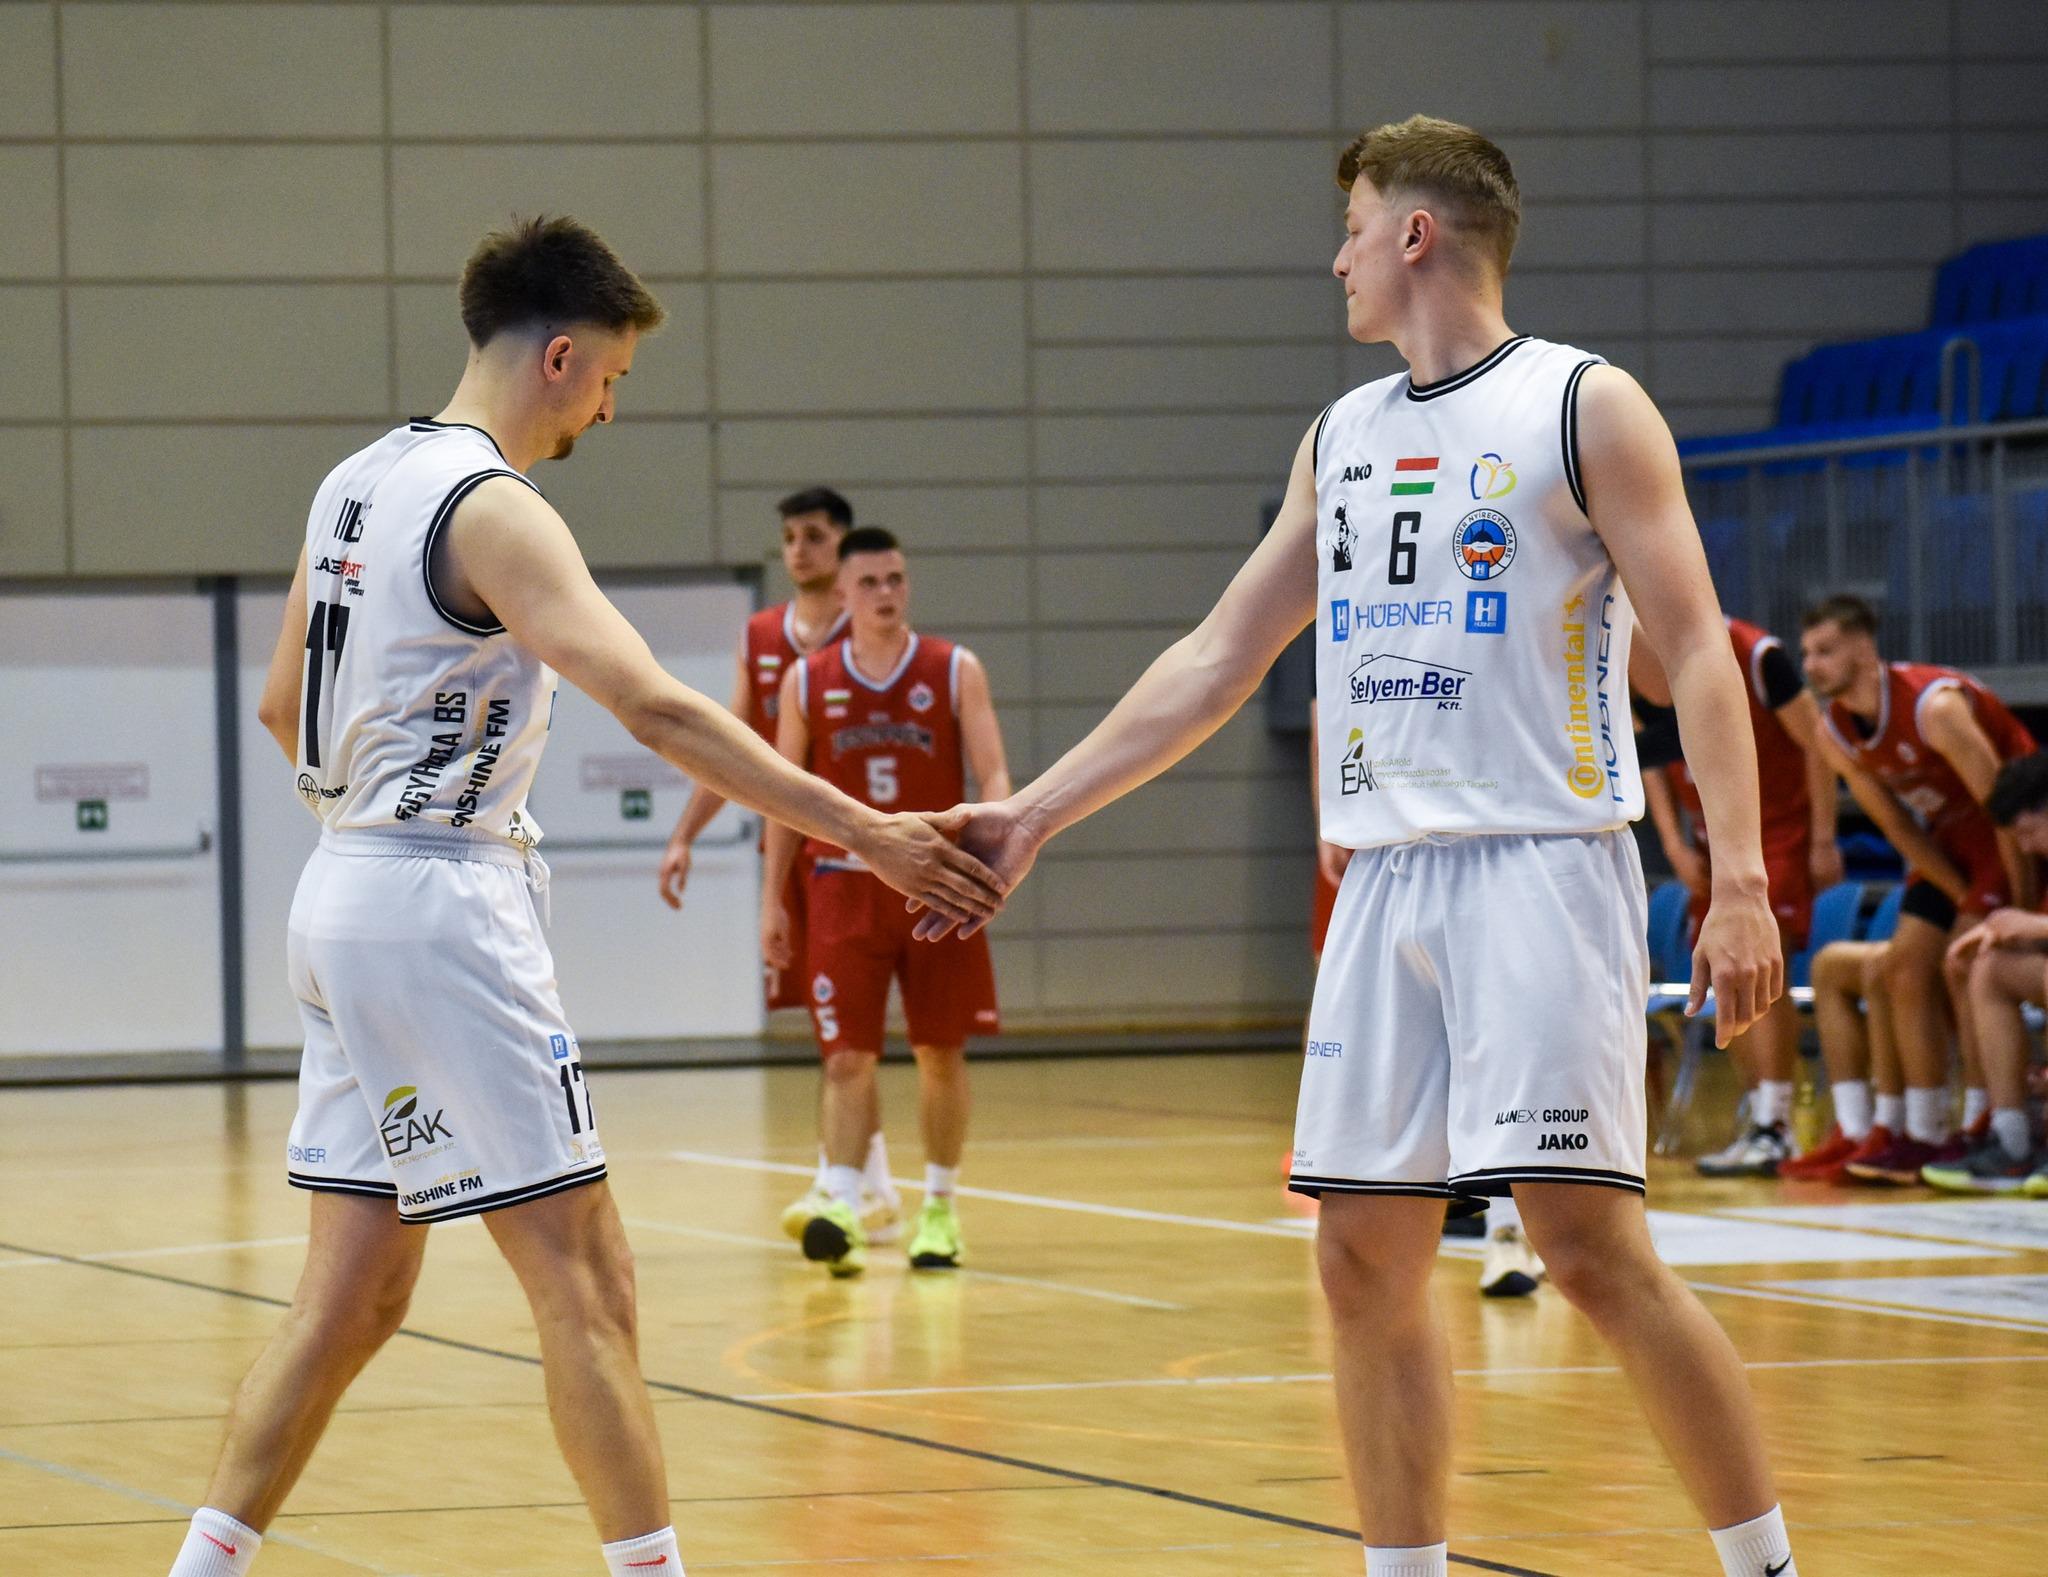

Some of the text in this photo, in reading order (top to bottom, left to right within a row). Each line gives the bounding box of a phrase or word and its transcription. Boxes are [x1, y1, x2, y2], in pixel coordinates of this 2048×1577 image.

[1340, 463, 1372, 483] AKO
[1388, 511, 1422, 585] 6
[1355, 600, 1453, 630] HÜBNER
[1351, 672, 1466, 704] Selyem-Ber
[434, 692, 466, 723] BS
[486, 699, 510, 737] FM
[1437, 701, 1462, 710] Kft.
[1563, 622, 1605, 799] Continental
[866, 756, 898, 803] 5
[817, 1006, 839, 1042] 5
[1305, 1041, 1342, 1058] BNER
[561, 1061, 594, 1135] 17
[1543, 1109, 1589, 1123] GROUP
[380, 1109, 454, 1158] EAK
[1537, 1133, 1589, 1150] JAKO
[400, 1182, 457, 1206] UNSHINE
[459, 1175, 483, 1192] FM
